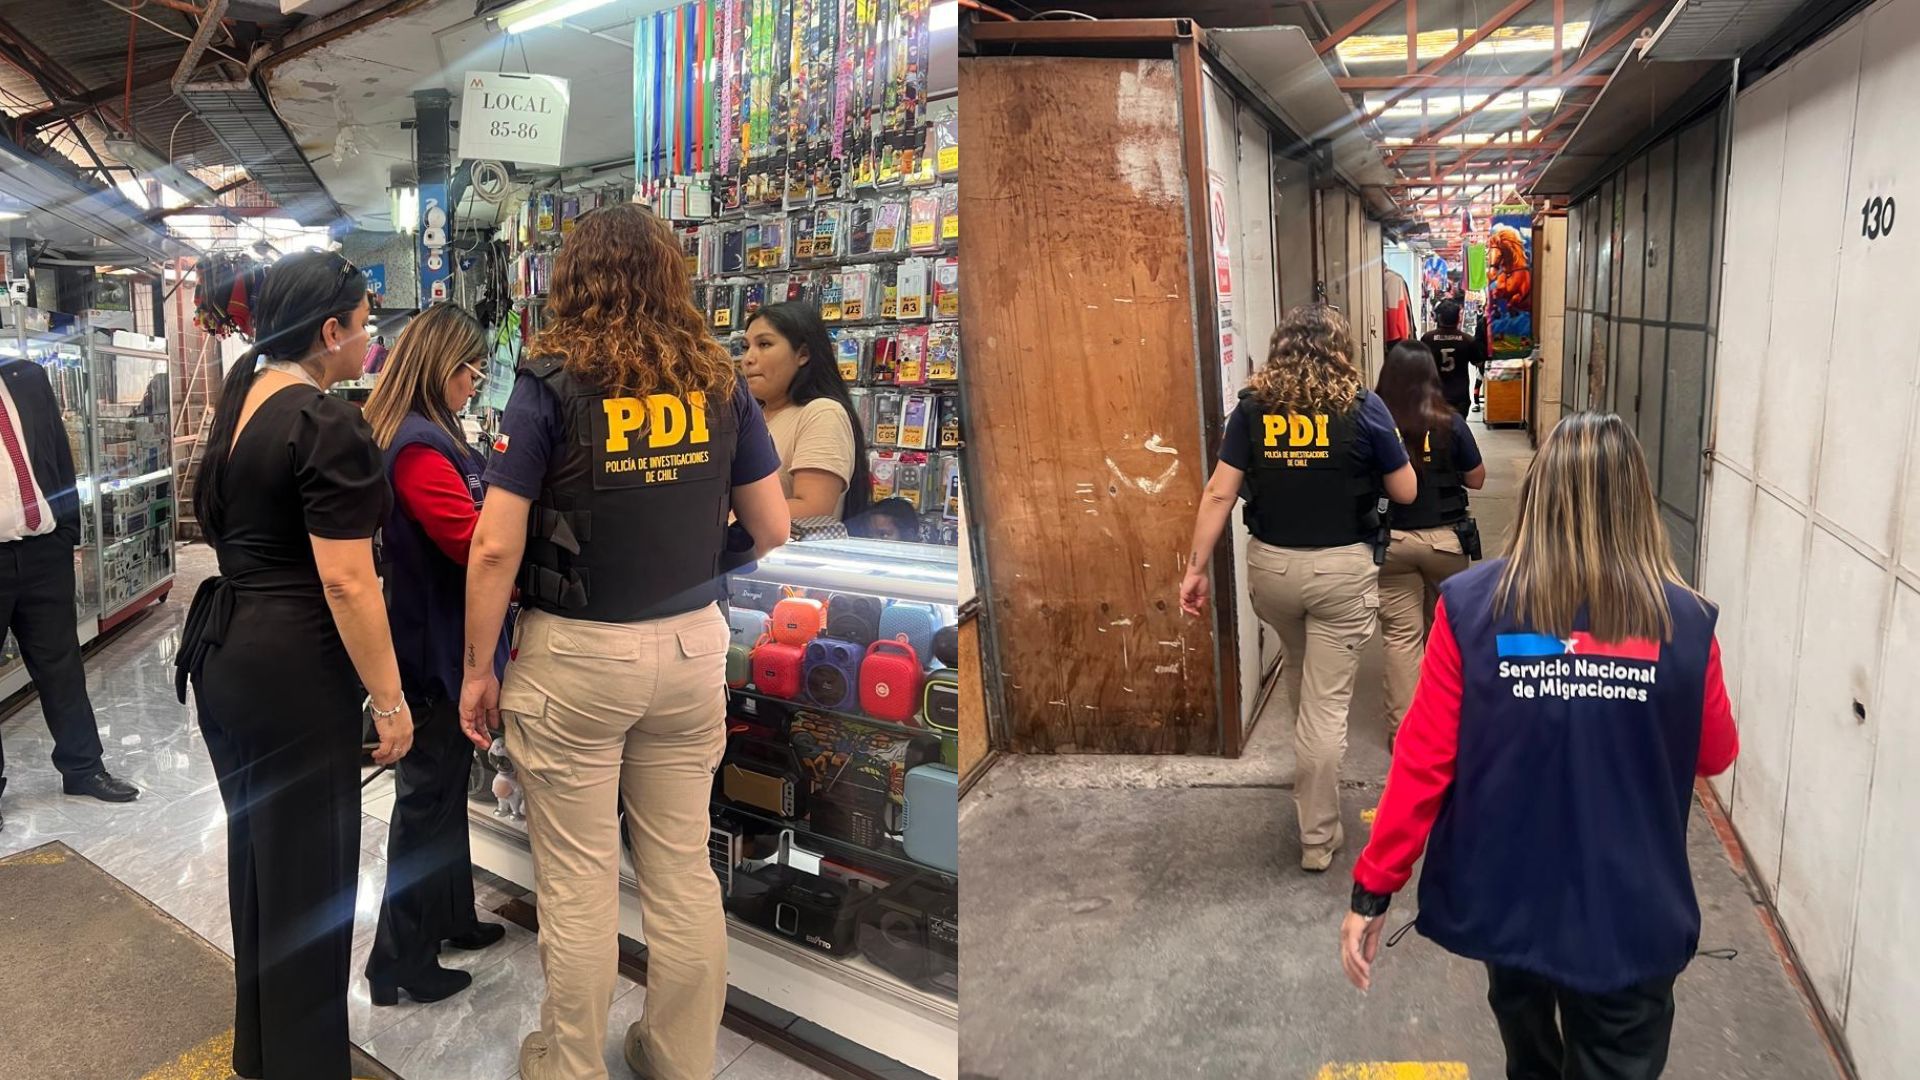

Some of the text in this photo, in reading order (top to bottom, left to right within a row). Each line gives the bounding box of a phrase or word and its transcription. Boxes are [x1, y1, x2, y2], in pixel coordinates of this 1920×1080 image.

[481, 93, 552, 115] LOCAL
[490, 120, 538, 139] 85-86
[1861, 196, 1895, 240] 130
[1440, 347, 1456, 372] 5
[602, 390, 710, 453] PDI
[1262, 414, 1330, 447] PDI
[605, 450, 710, 473] POLICÍA DE INVESTIGACIONES
[1264, 450, 1329, 459] POLICÍA DE INVESTIGACIONES
[1287, 459, 1308, 467] DE CHILE
[645, 468, 679, 483] DE CHILE
[1499, 659, 1656, 684] Servicio Nacional
[1512, 678, 1648, 702] de Migraciones
